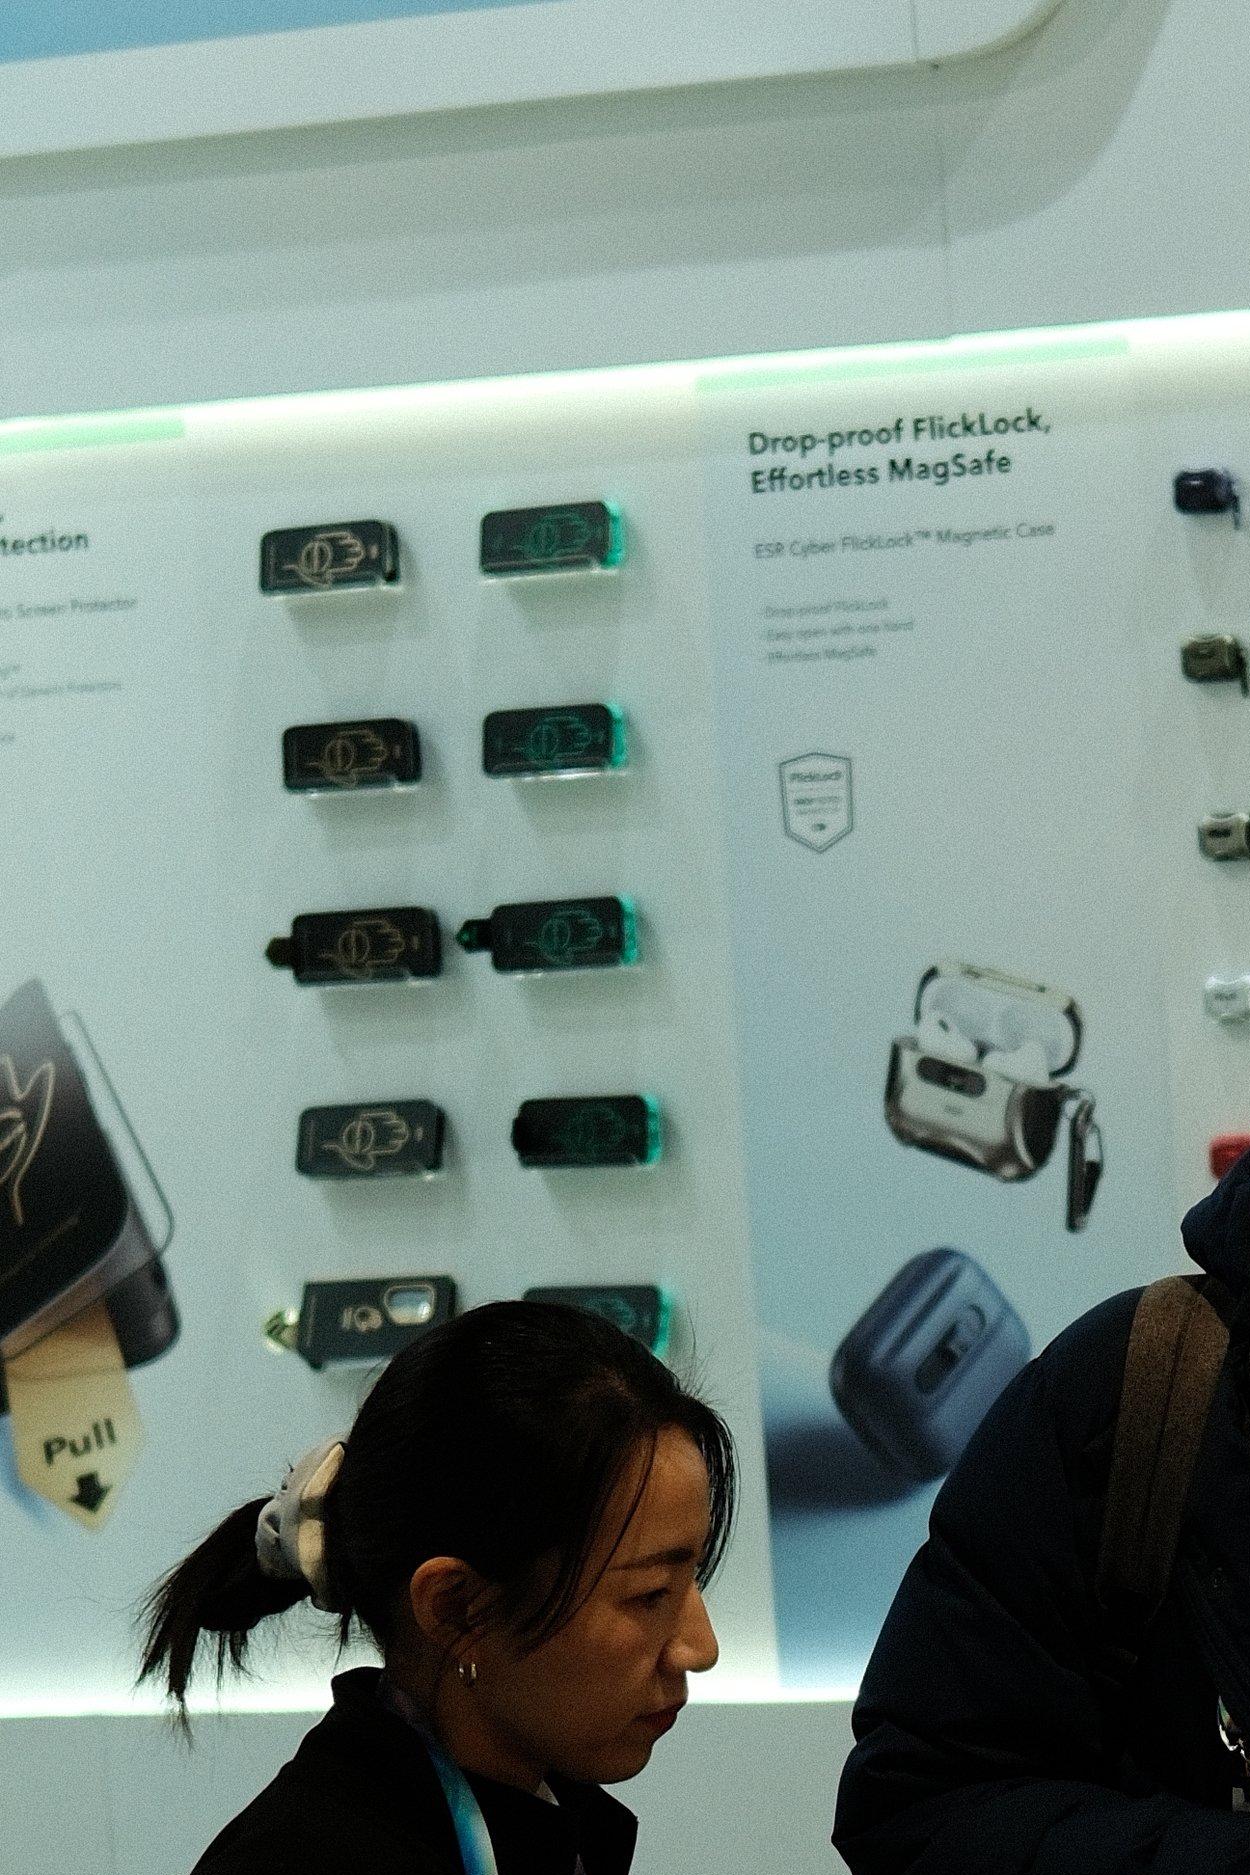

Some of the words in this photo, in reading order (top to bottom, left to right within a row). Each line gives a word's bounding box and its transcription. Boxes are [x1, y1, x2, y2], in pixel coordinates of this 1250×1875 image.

[748, 417, 904, 457] Drop-proof
[913, 407, 1050, 441] FlickLock,
[751, 464, 879, 493] Effortless
[889, 449, 1011, 485] MagSafe
[754, 542, 784, 559] ESR
[789, 541, 835, 558] Cyber
[936, 527, 1010, 547] Magnetic
[1016, 522, 1055, 538] Case
[43, 1418, 118, 1467] Pull
